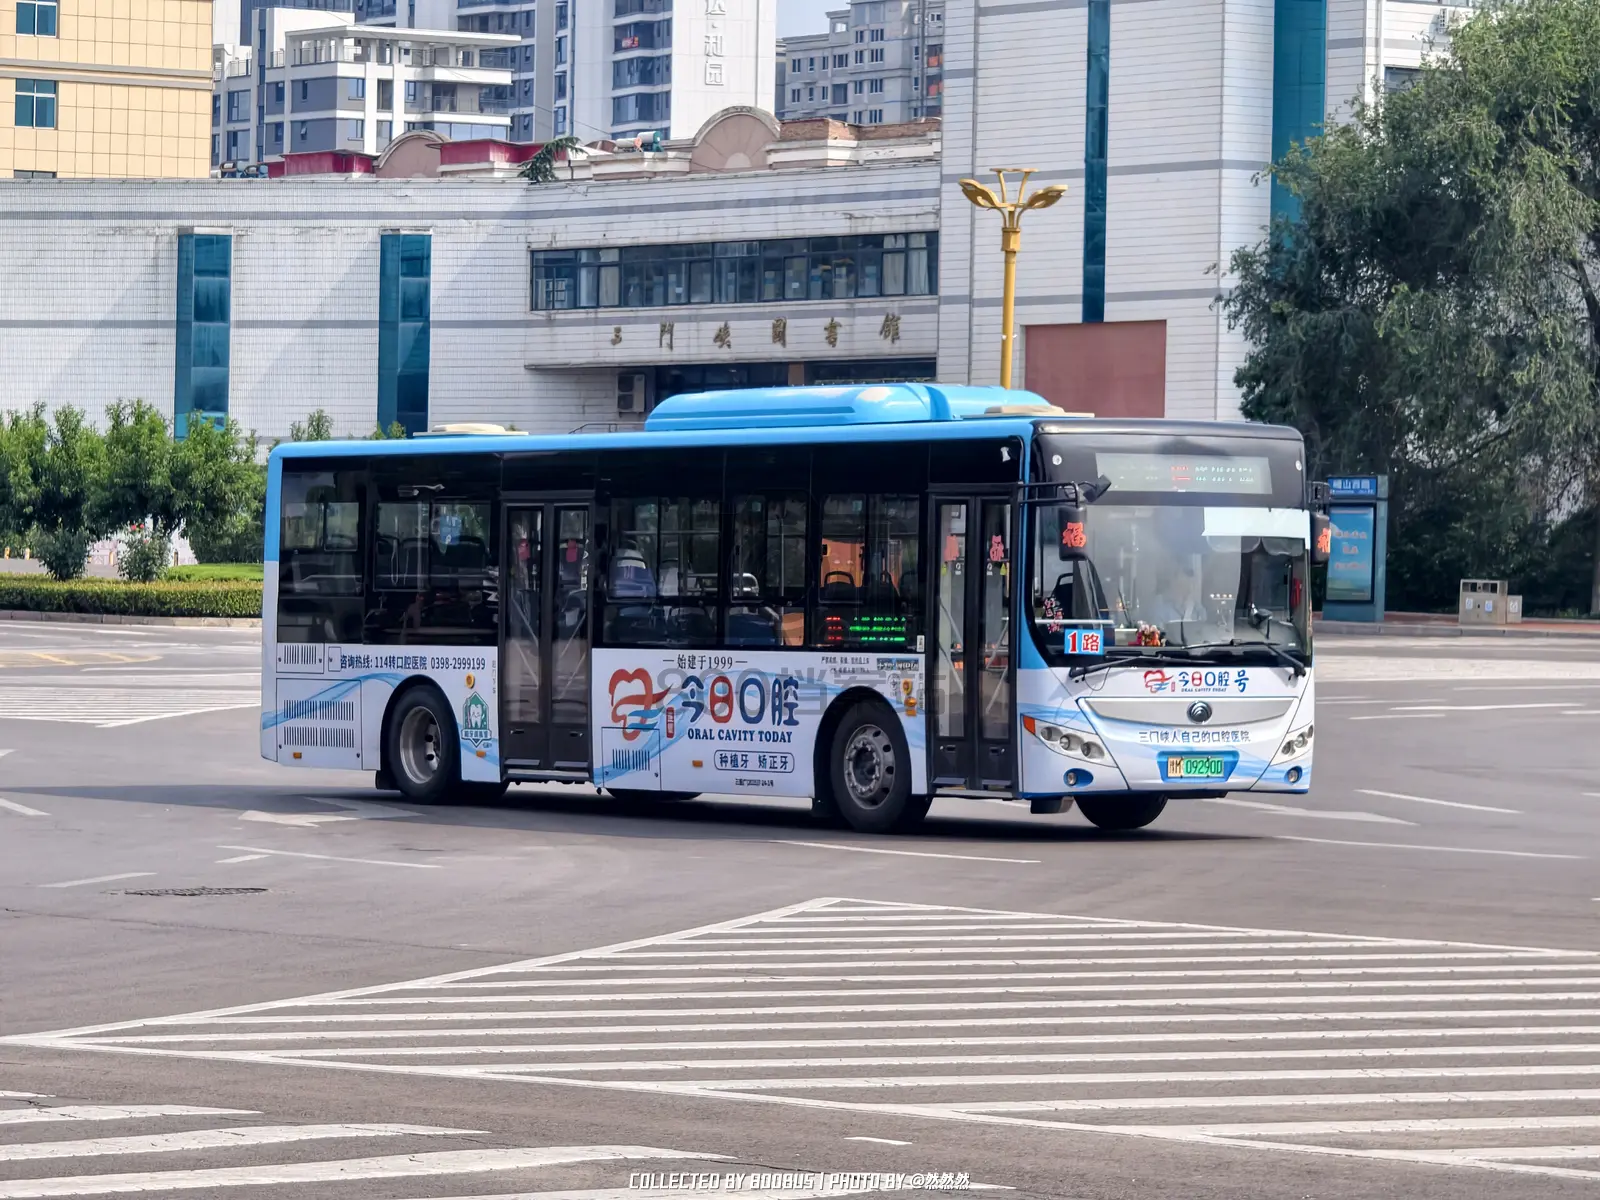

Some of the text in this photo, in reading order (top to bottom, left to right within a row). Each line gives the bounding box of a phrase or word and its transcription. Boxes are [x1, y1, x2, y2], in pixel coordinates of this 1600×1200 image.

[1068, 631, 1100, 653] 1路
[431, 657, 486, 670] 0398-2999199
[681, 675, 800, 727] 今日口腔
[687, 728, 793, 743] ORAL CAVITY TODAY
[1139, 730, 1251, 743] 三门峡人自己的口腔医院
[719, 753, 749, 768] 种植牙
